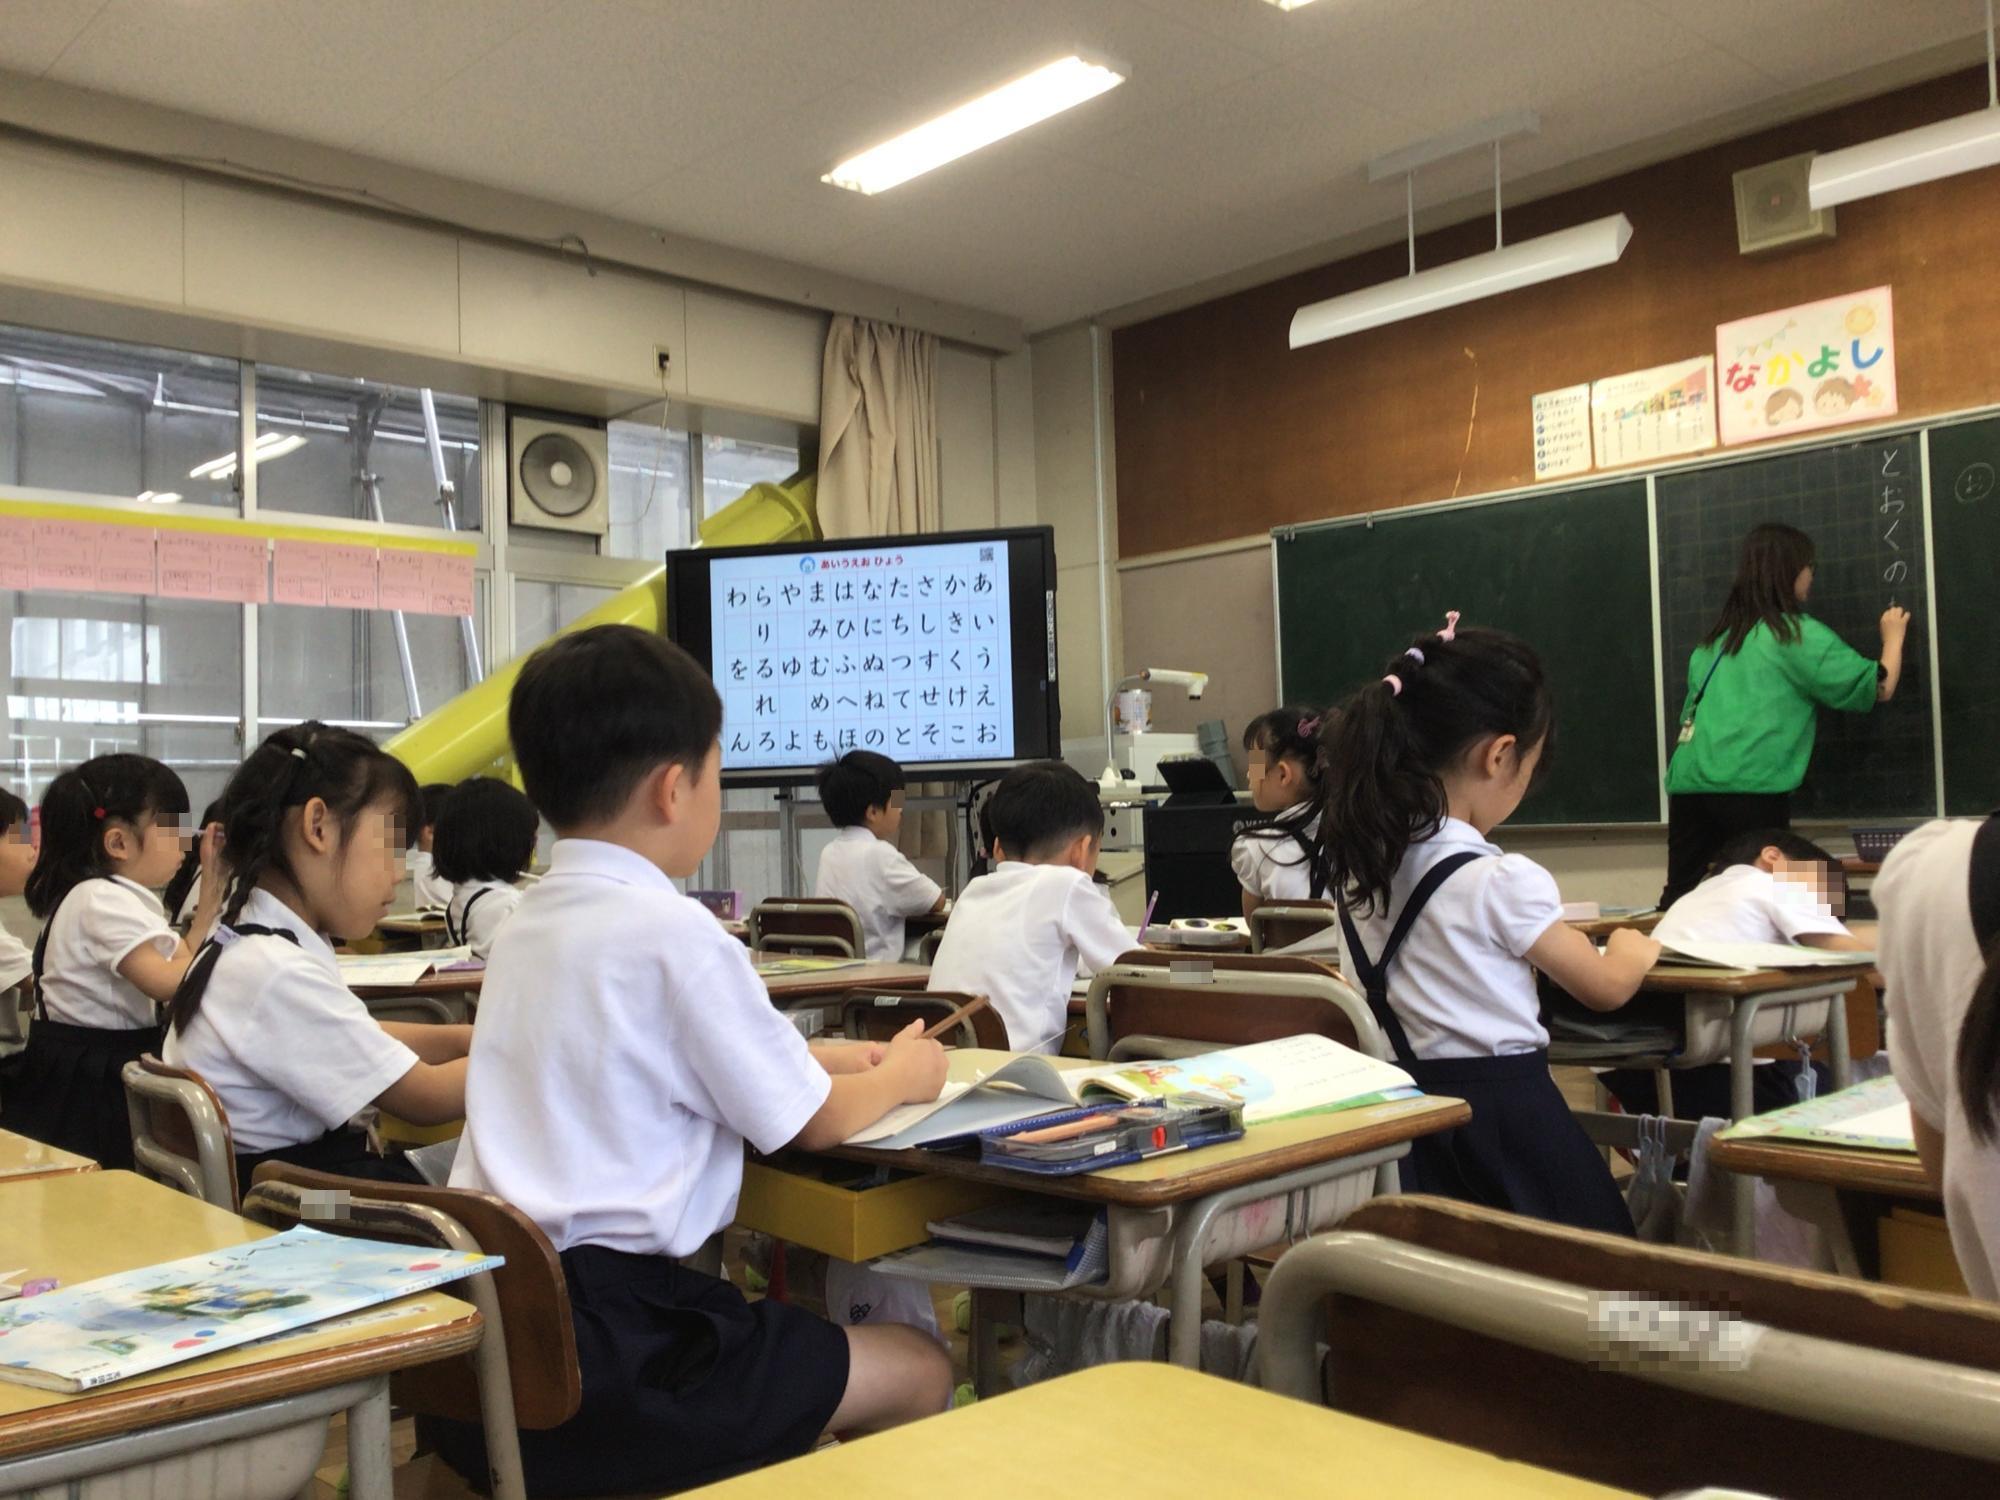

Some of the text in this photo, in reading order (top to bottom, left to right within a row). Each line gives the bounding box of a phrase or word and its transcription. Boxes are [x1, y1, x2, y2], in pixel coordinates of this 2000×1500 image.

[1726, 338, 1884, 393] なかよし
[820, 553, 905, 570] あいうえお ひょう
[727, 572, 993, 608] わ ら や ま は な た さ か あ
[757, 611, 995, 643] り み ひ に ち し き い
[731, 658, 748, 681] を
[756, 657, 774, 679] る
[782, 656, 801, 677] ゆ
[810, 655, 830, 677] む
[835, 655, 857, 674] ふ
[862, 653, 885, 673] ぬ
[919, 649, 939, 672] す
[950, 649, 961, 671] く
[977, 647, 991, 669] う
[755, 694, 776, 716] れ
[810, 692, 830, 711] め
[864, 689, 885, 711] ね
[893, 689, 910, 709] て
[919, 686, 940, 706] せ
[948, 685, 967, 707] け
[976, 684, 995, 707] え
[730, 722, 997, 753] ん ろ よ も ほ の と そ こ お
